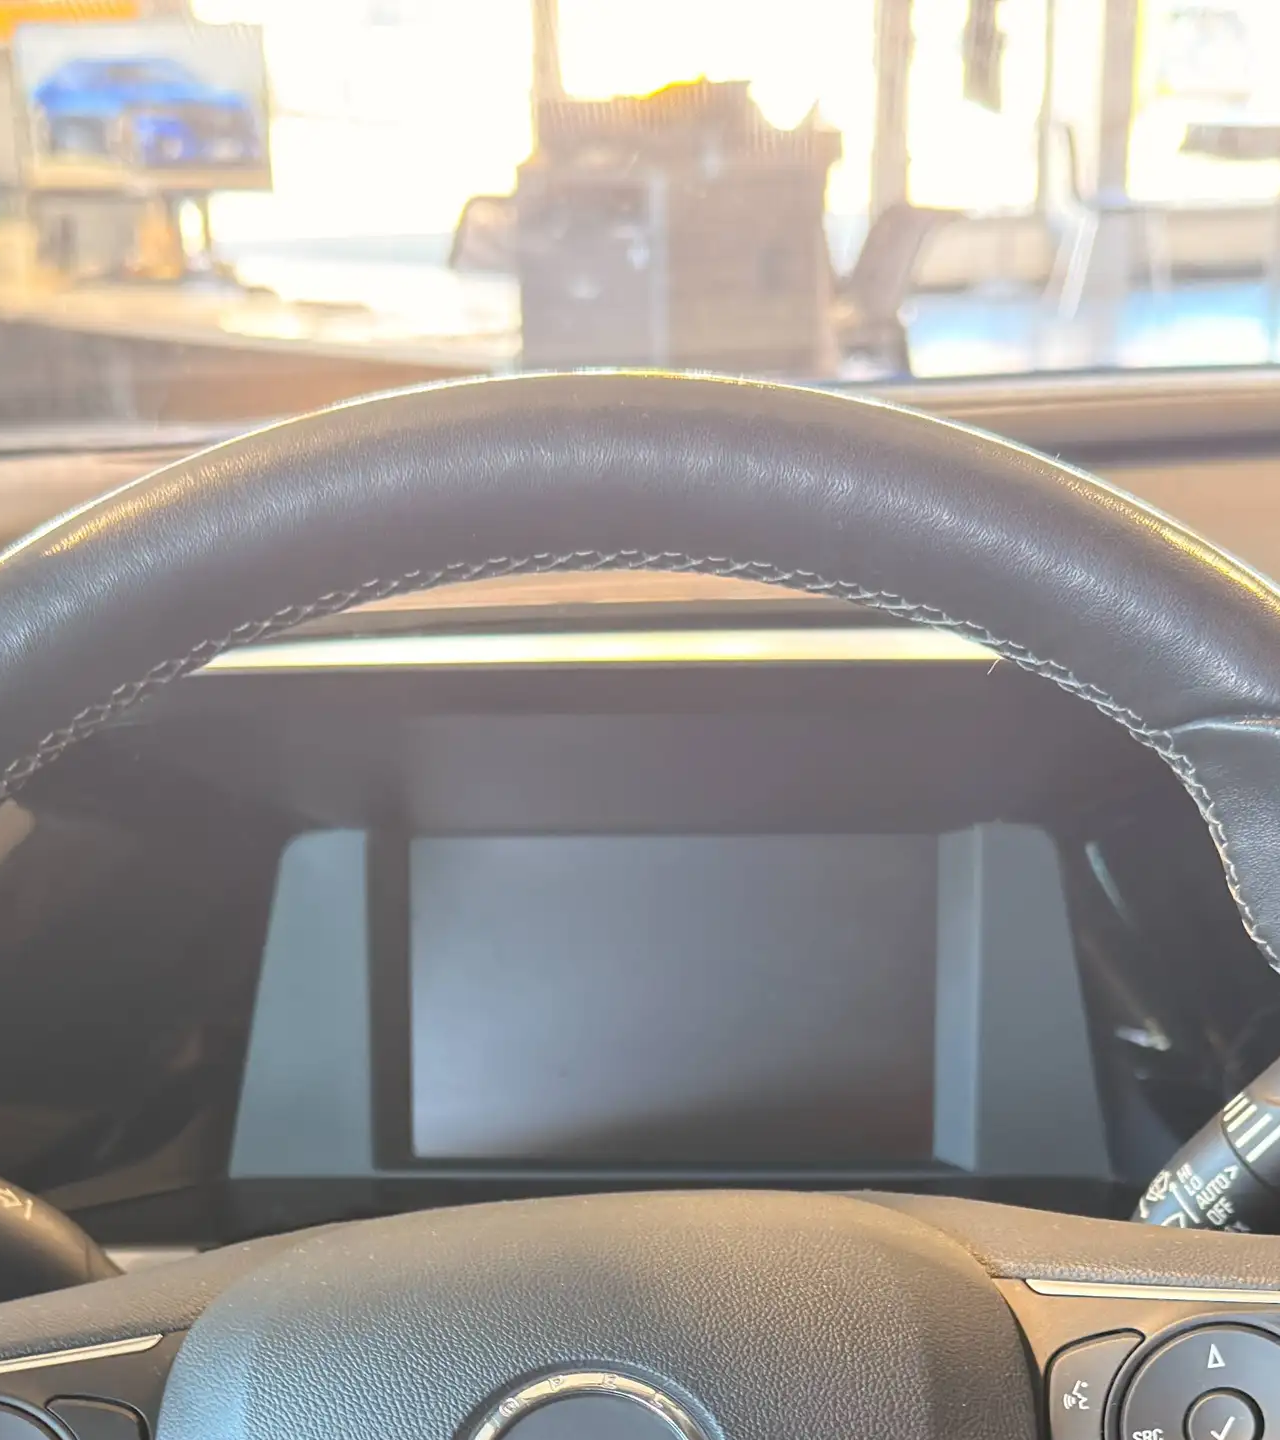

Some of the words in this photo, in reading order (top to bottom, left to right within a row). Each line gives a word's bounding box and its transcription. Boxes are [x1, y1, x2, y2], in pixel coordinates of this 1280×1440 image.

[1183, 1175, 1203, 1197] LO
[1195, 1172, 1231, 1211] AUTO
[1206, 1196, 1235, 1226] OFF
